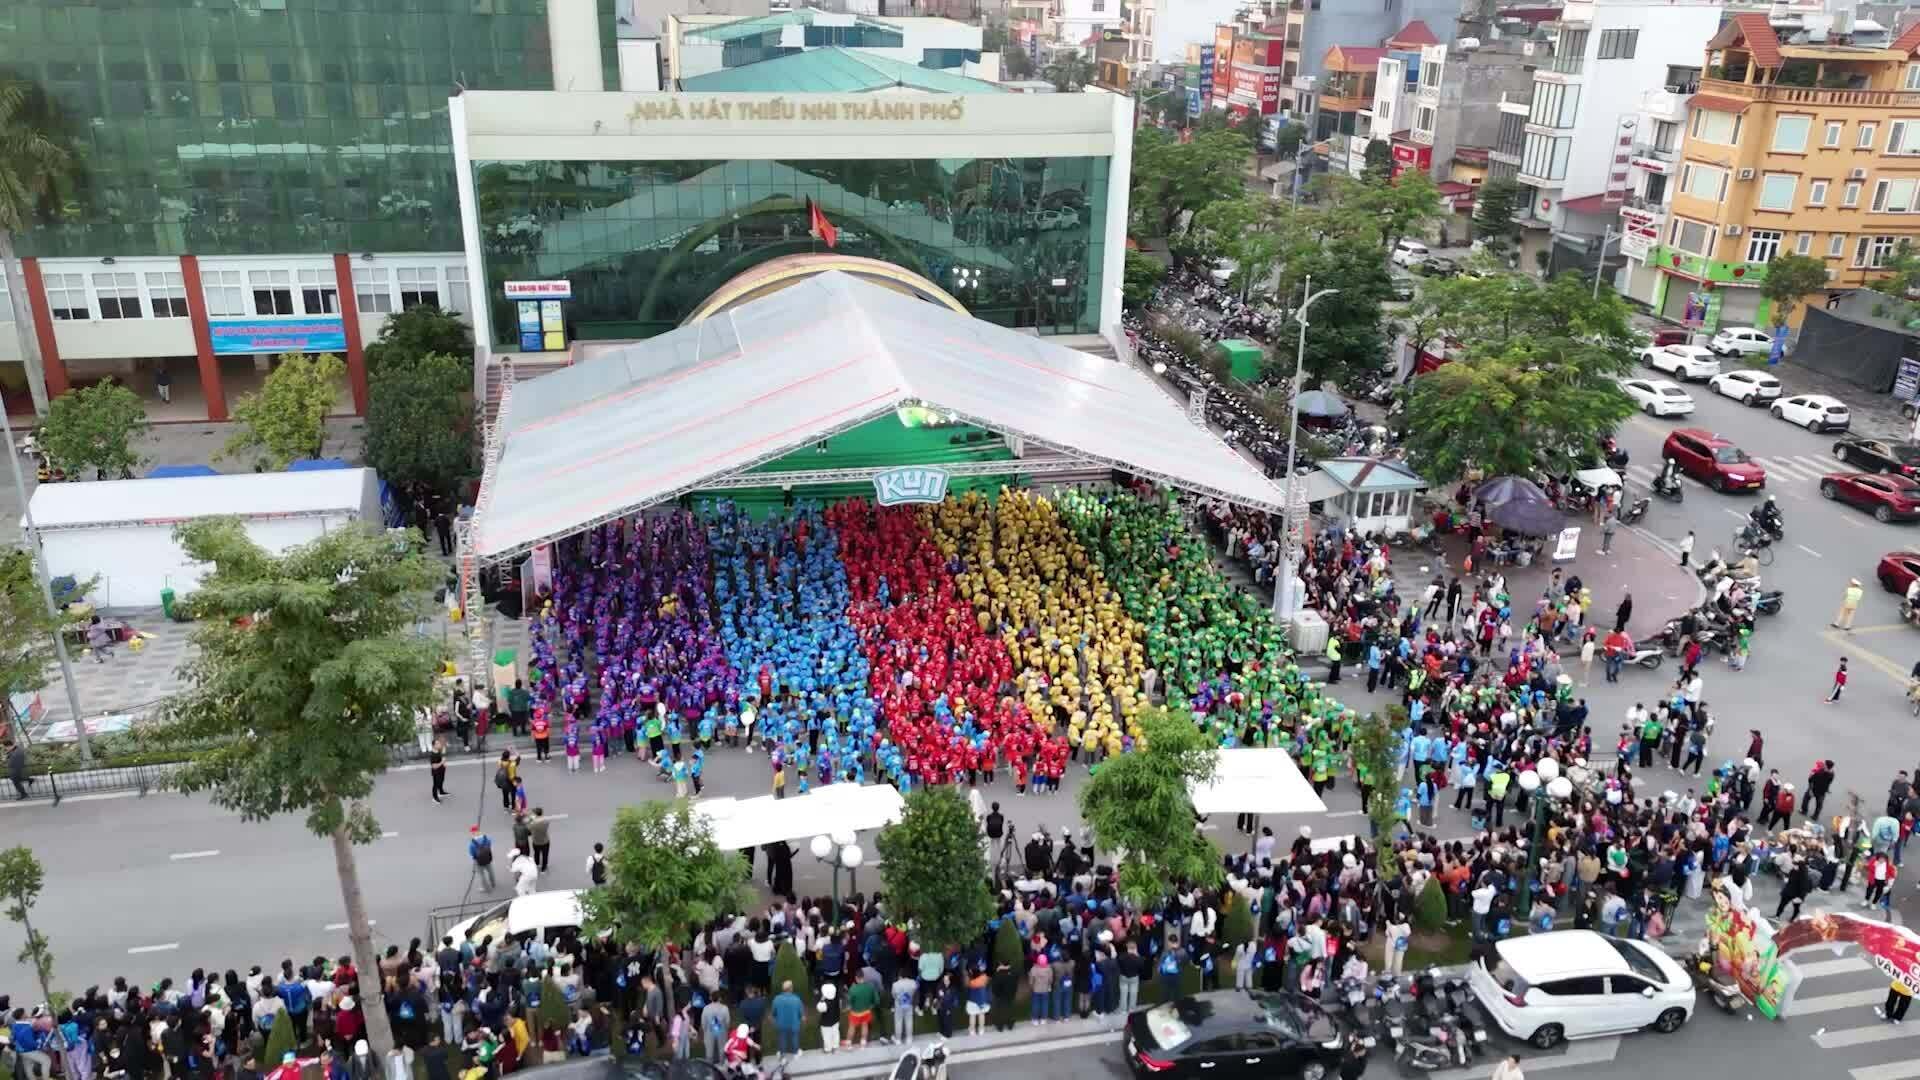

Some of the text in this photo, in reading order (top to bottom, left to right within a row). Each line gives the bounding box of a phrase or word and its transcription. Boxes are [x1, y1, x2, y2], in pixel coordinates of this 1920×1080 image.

[635, 96, 966, 120] NHÀ HÁT THIẾU NHI THÀNH PHỐ
